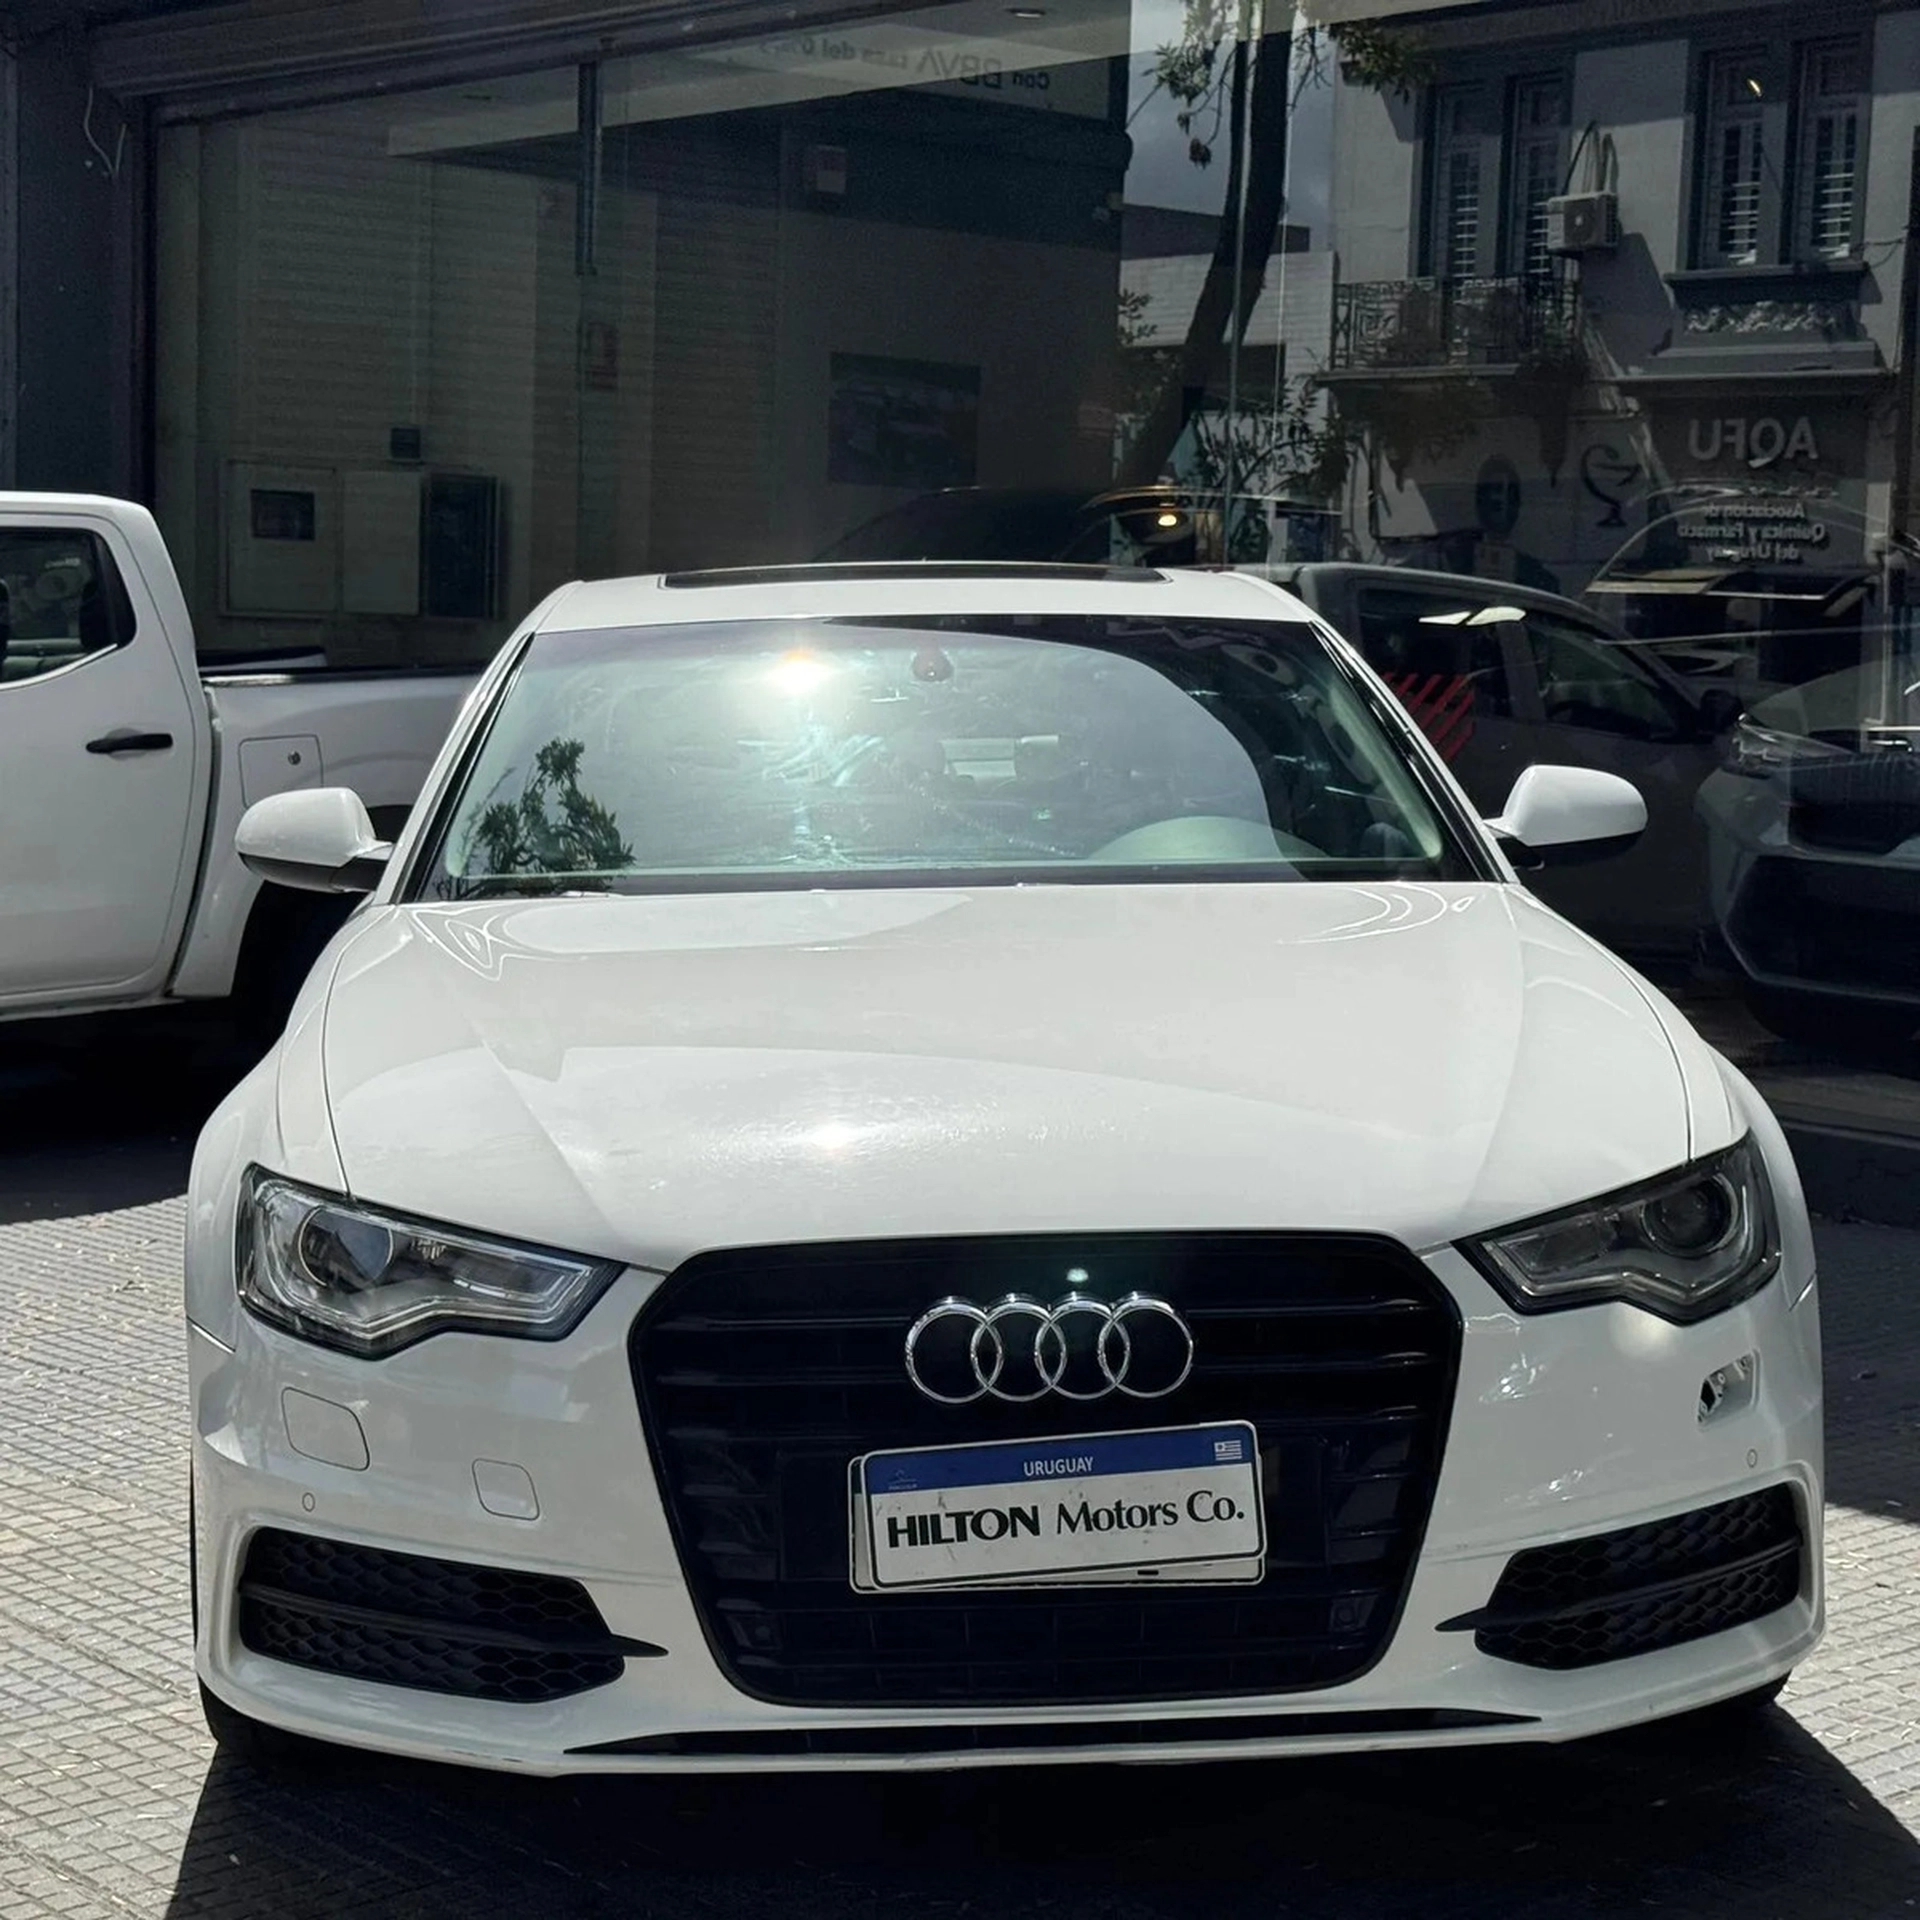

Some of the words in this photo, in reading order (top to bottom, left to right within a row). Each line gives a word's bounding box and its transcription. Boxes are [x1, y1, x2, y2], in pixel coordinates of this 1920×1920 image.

[1023, 1456, 1094, 1477] URUGUAY
[887, 1505, 1040, 1548] HILTON
[1056, 1502, 1177, 1535] Motors
[1186, 1490, 1245, 1523] Co.
